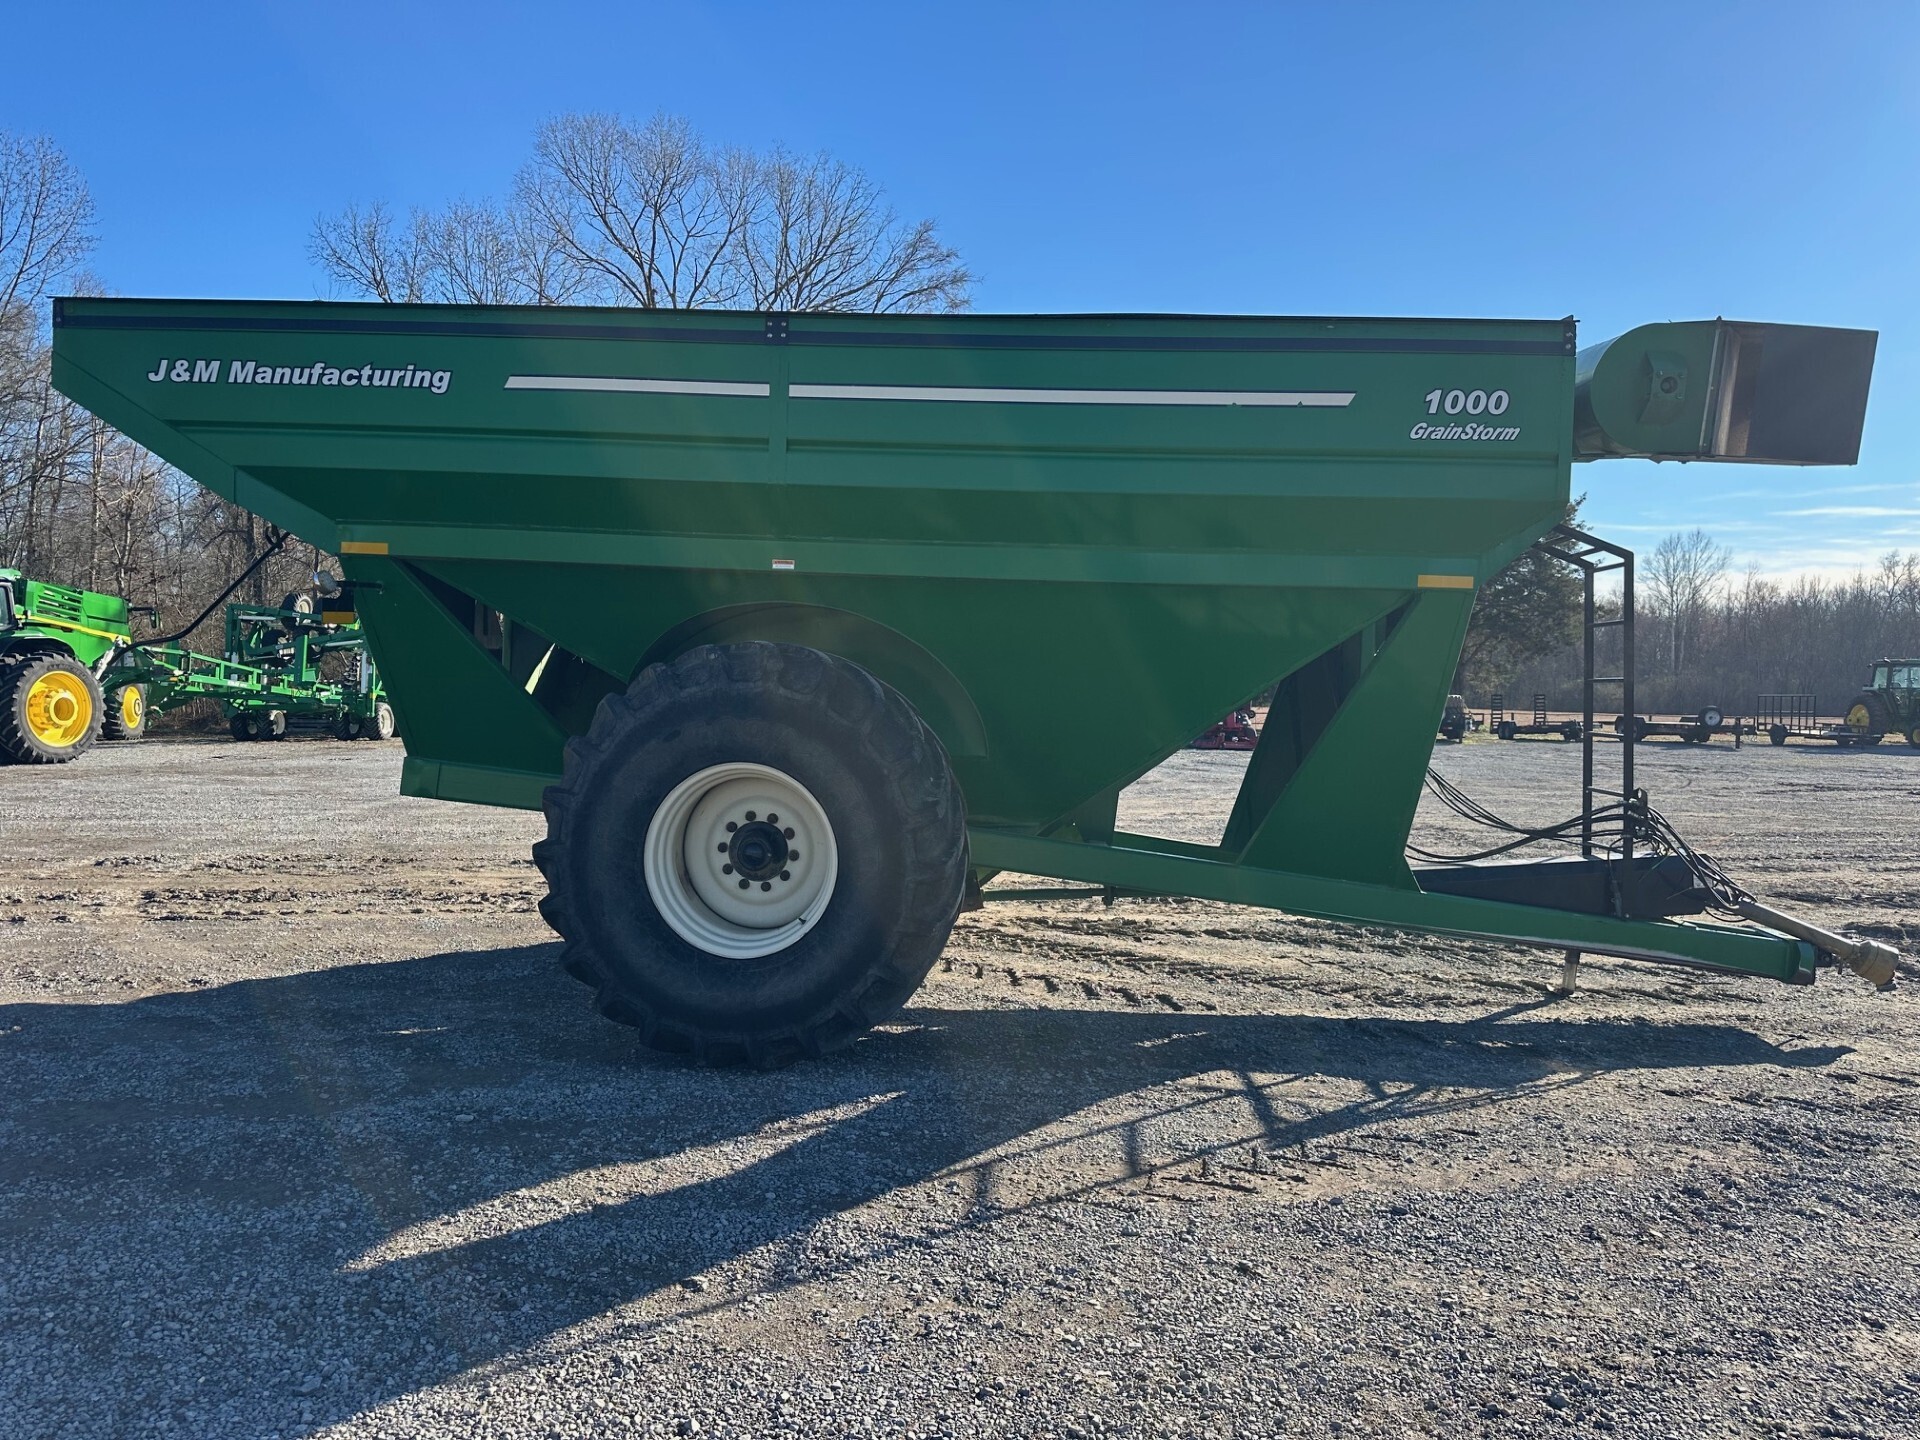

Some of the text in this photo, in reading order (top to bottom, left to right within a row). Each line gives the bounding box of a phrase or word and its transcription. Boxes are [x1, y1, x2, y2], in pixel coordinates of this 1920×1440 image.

[147, 358, 452, 394] J&M Manufacturing
[1424, 389, 1510, 415] 1000
[1409, 422, 1521, 440] GrainStorm
